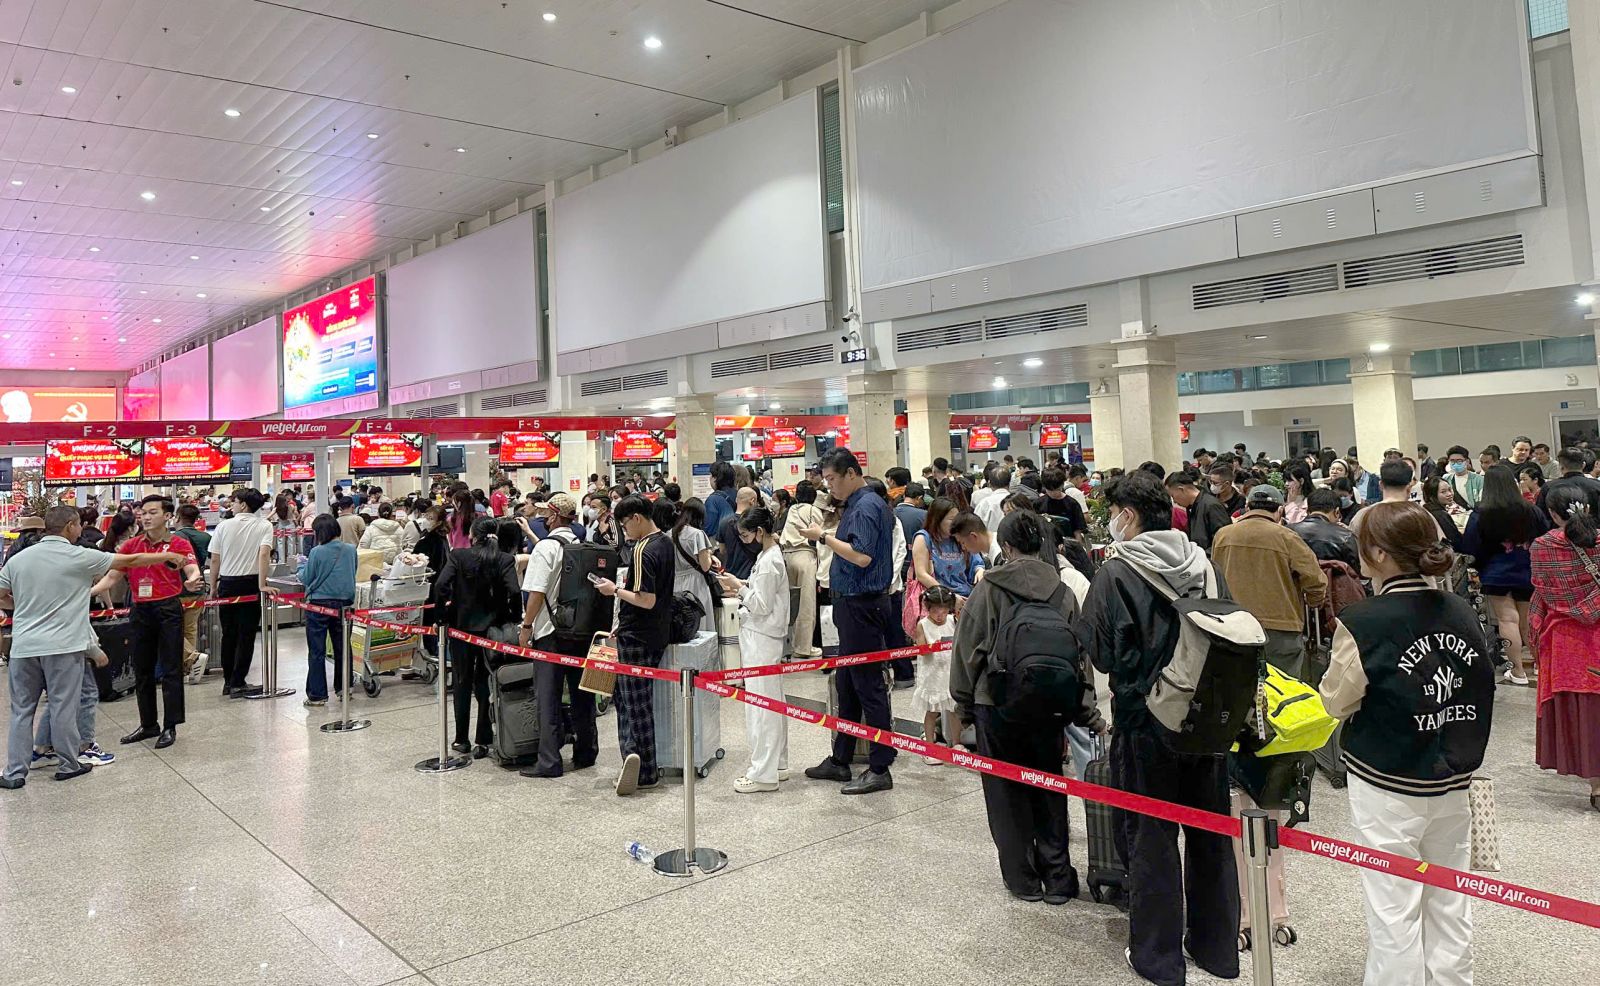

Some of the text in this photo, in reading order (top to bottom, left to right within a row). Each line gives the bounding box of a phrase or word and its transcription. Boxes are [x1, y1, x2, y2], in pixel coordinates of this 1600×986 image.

[847, 350, 865, 361] 9:36
[1398, 633, 1479, 675] NEW YORK
[1422, 665, 1463, 704] 19 NY 03
